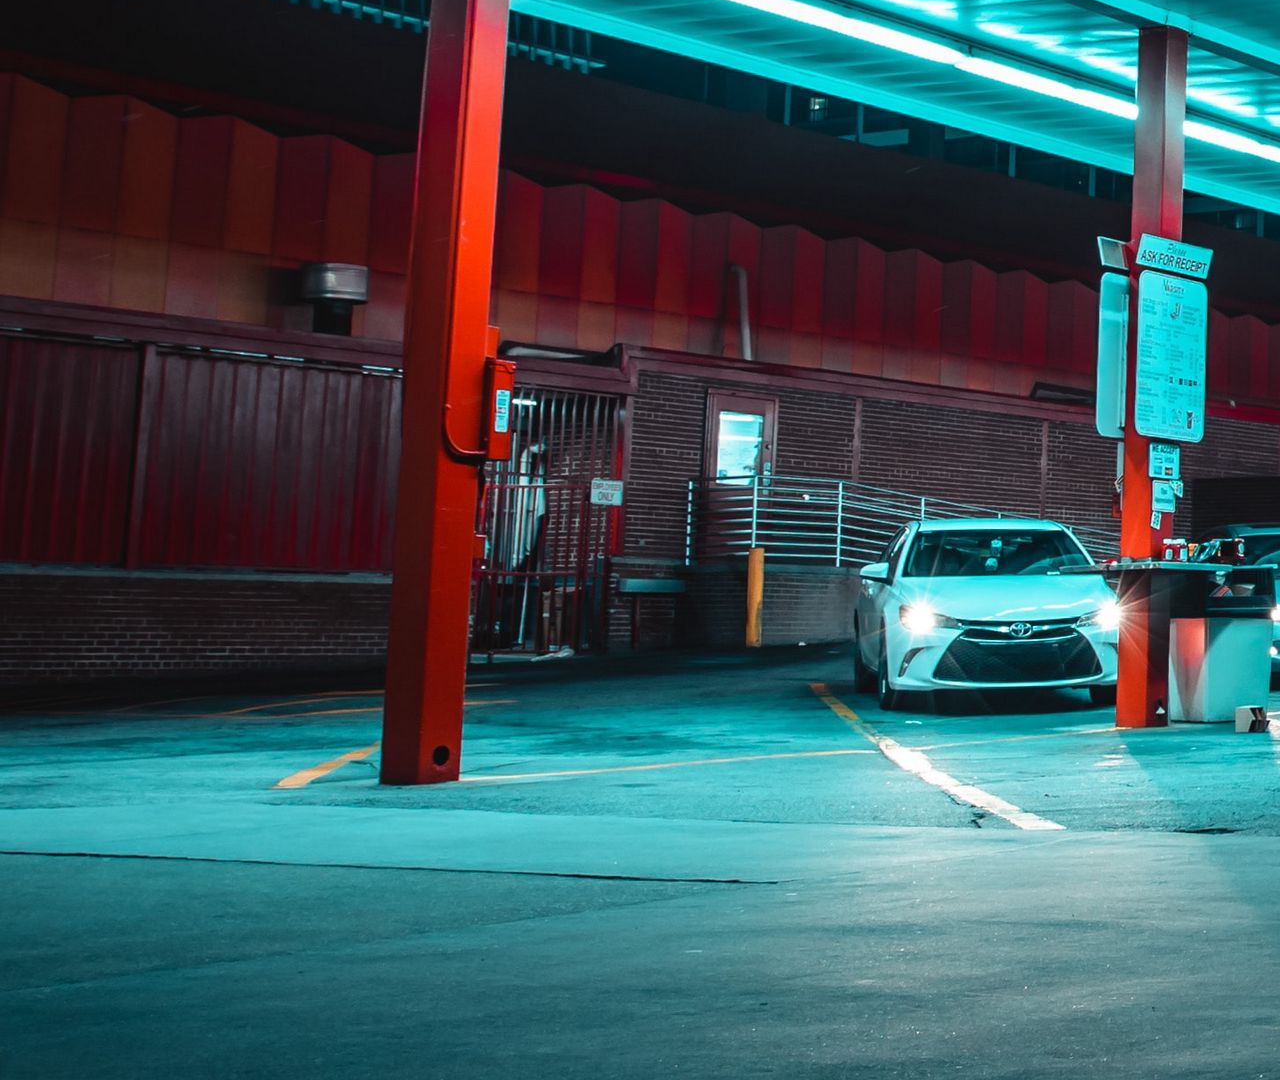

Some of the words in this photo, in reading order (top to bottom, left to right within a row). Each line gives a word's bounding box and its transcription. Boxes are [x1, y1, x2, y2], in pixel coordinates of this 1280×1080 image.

[1141, 249, 1157, 263] ASK
[1157, 253, 1175, 267] FOR
[1175, 256, 1208, 275] RECEIPT
[597, 491, 615, 502] ONLY
